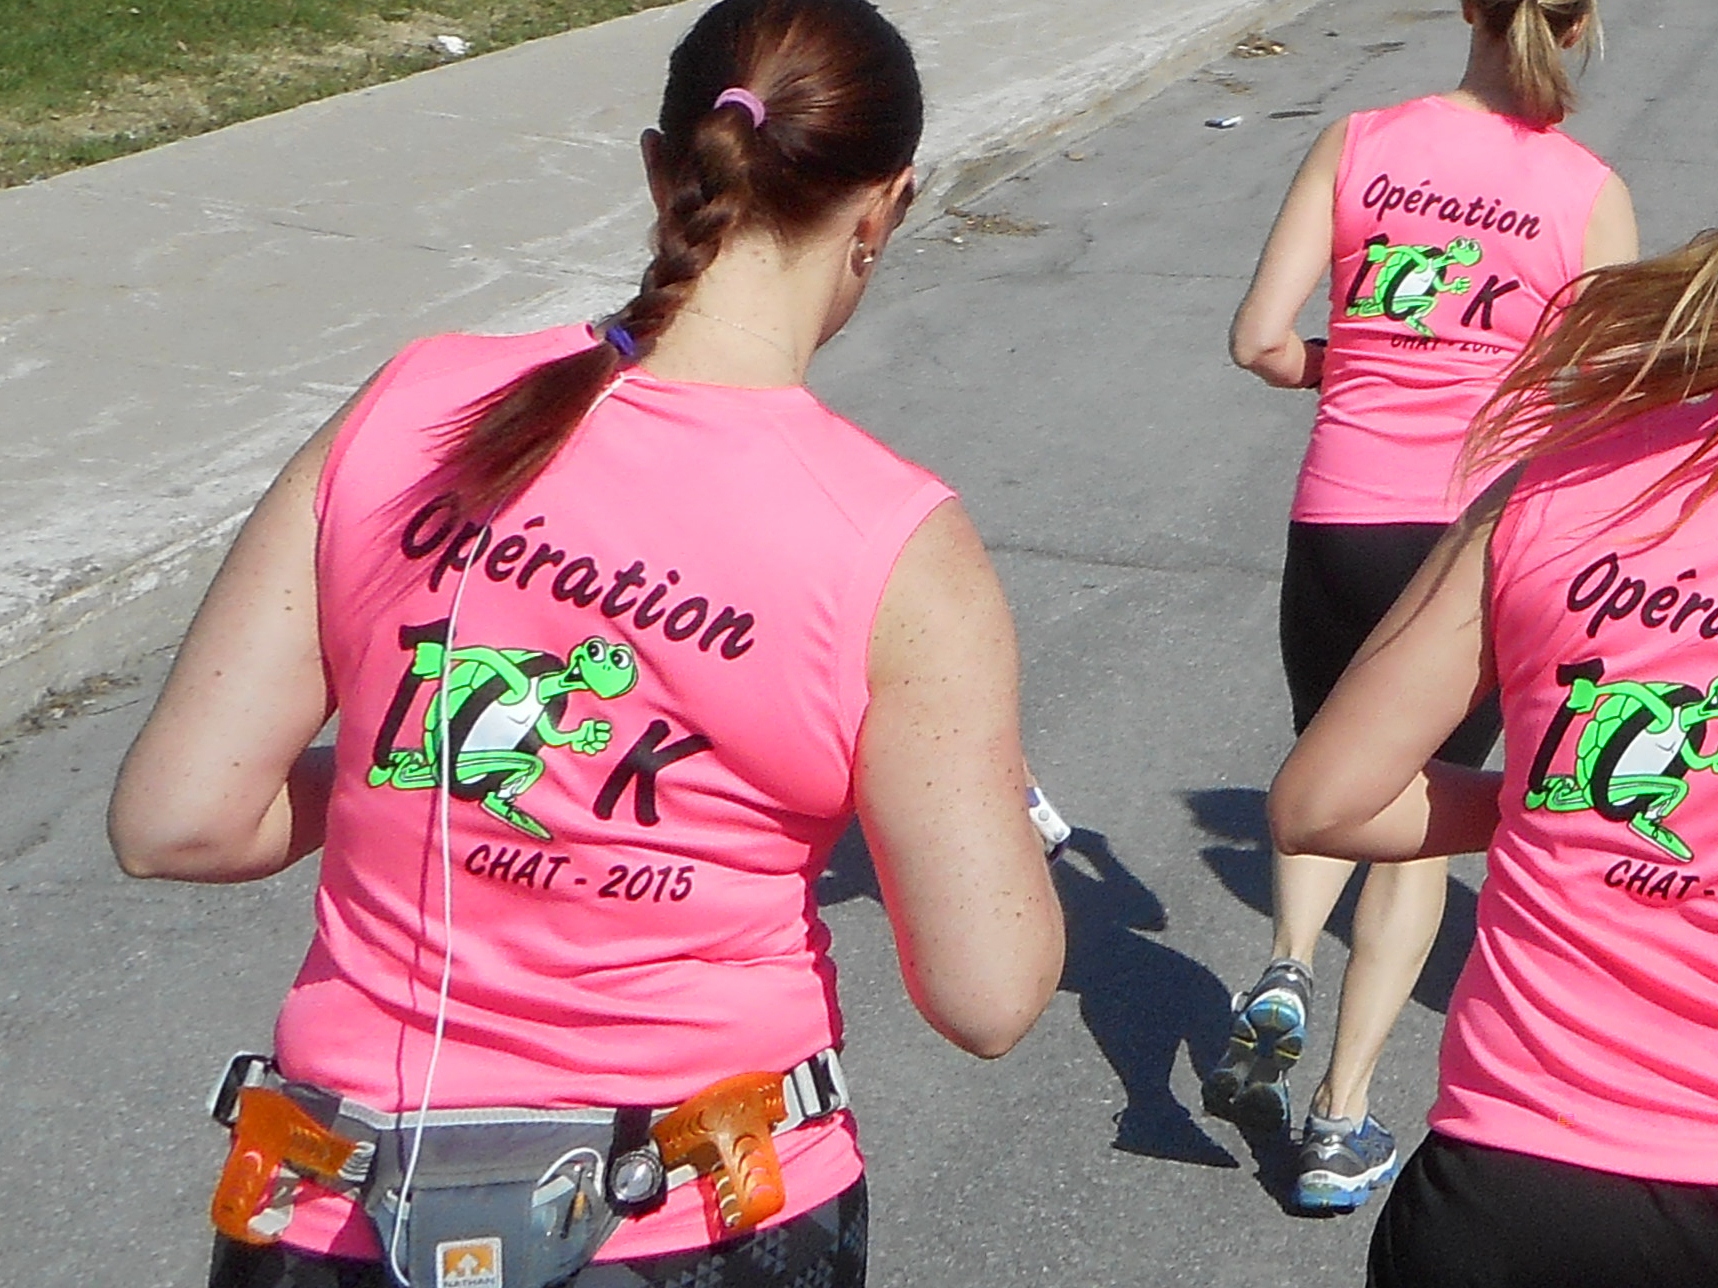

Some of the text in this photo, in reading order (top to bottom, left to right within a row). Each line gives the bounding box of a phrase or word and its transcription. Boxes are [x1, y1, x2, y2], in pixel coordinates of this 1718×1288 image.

[1362, 173, 1541, 241] Opération
[399, 491, 756, 660] Opération
[465, 843, 572, 890] CHAT
[598, 864, 694, 903] 2015
[1604, 859, 1700, 901] CHAT
